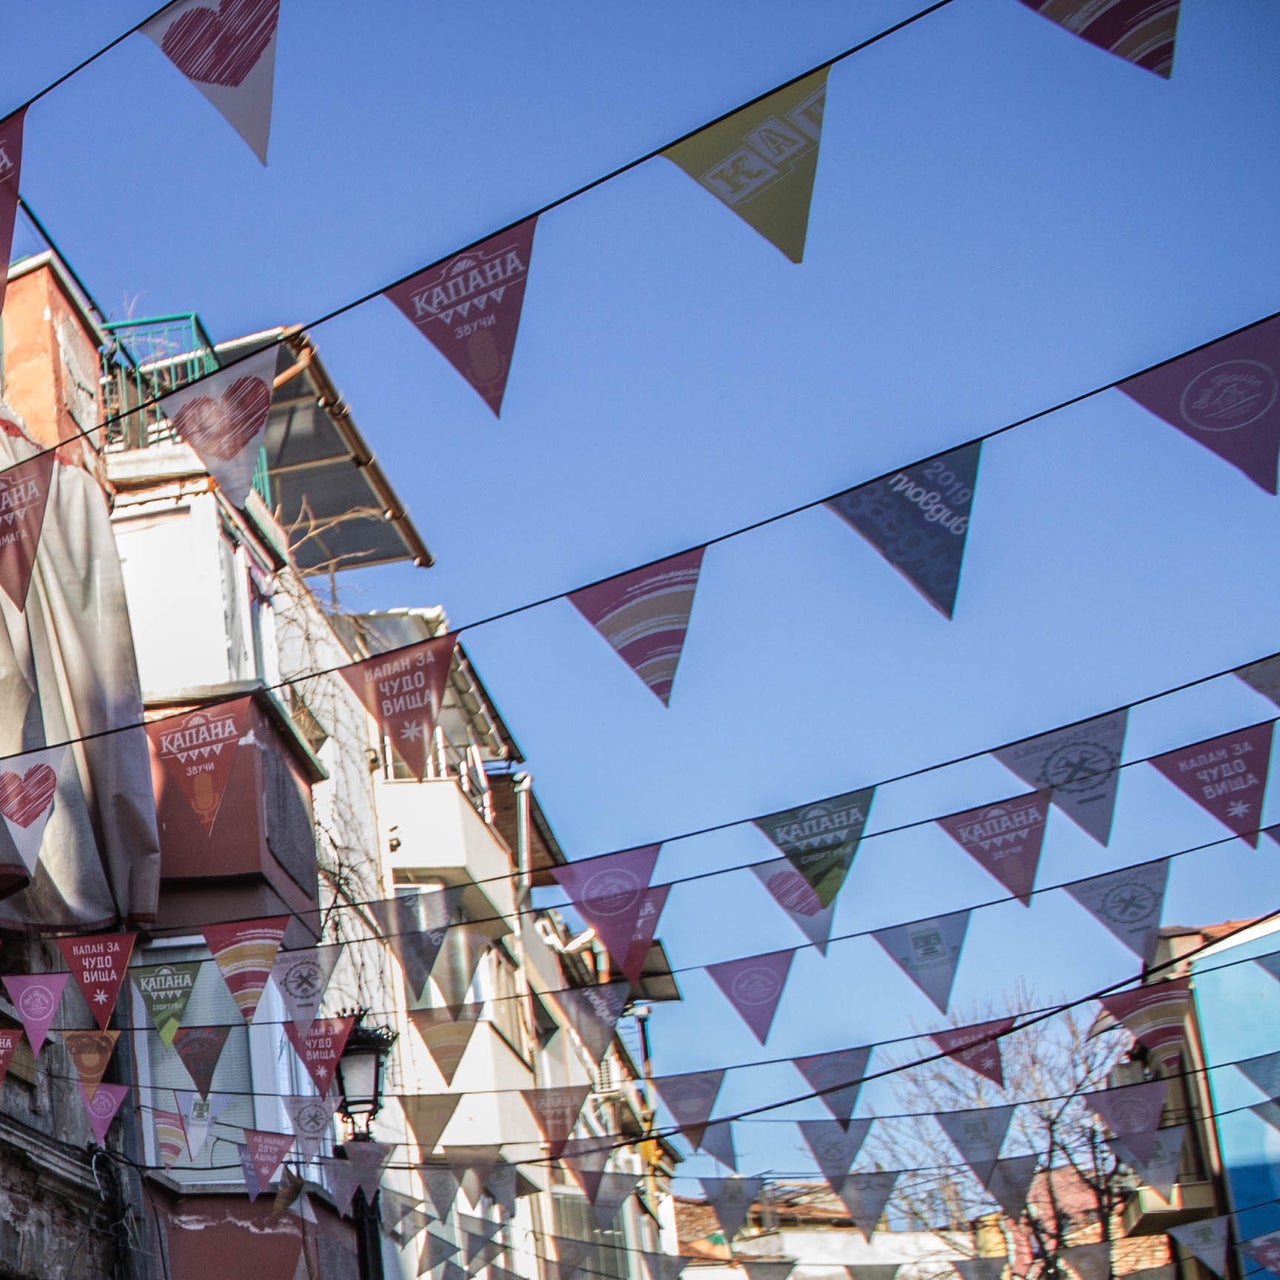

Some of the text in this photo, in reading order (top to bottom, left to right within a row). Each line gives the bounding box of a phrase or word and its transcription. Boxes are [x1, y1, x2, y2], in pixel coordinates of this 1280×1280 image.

[412, 251, 526, 316] КАПАНА
[455, 315, 496, 340] ЗВУЧИ
[923, 461, 970, 505] 2019
[416, 650, 435, 667] ЗА
[379, 671, 425, 697] ЧУДО
[382, 690, 433, 717] ВИЩА
[160, 719, 238, 753] КАПАНА
[186, 763, 215, 777] ЗВУЧИ
[1178, 742, 1253, 772] КАПАН ЗА
[1197, 759, 1246, 782] ЧУДО
[1203, 773, 1259, 800] ВИЩА
[775, 808, 864, 843] КАПАНА
[958, 807, 1044, 843] КАПАНА
[73, 942, 119, 955] КАПАН ЗА
[82, 956, 111, 969] ЧУДО
[83, 971, 117, 983] ВИЩА
[141, 974, 192, 992] КАПАНА
